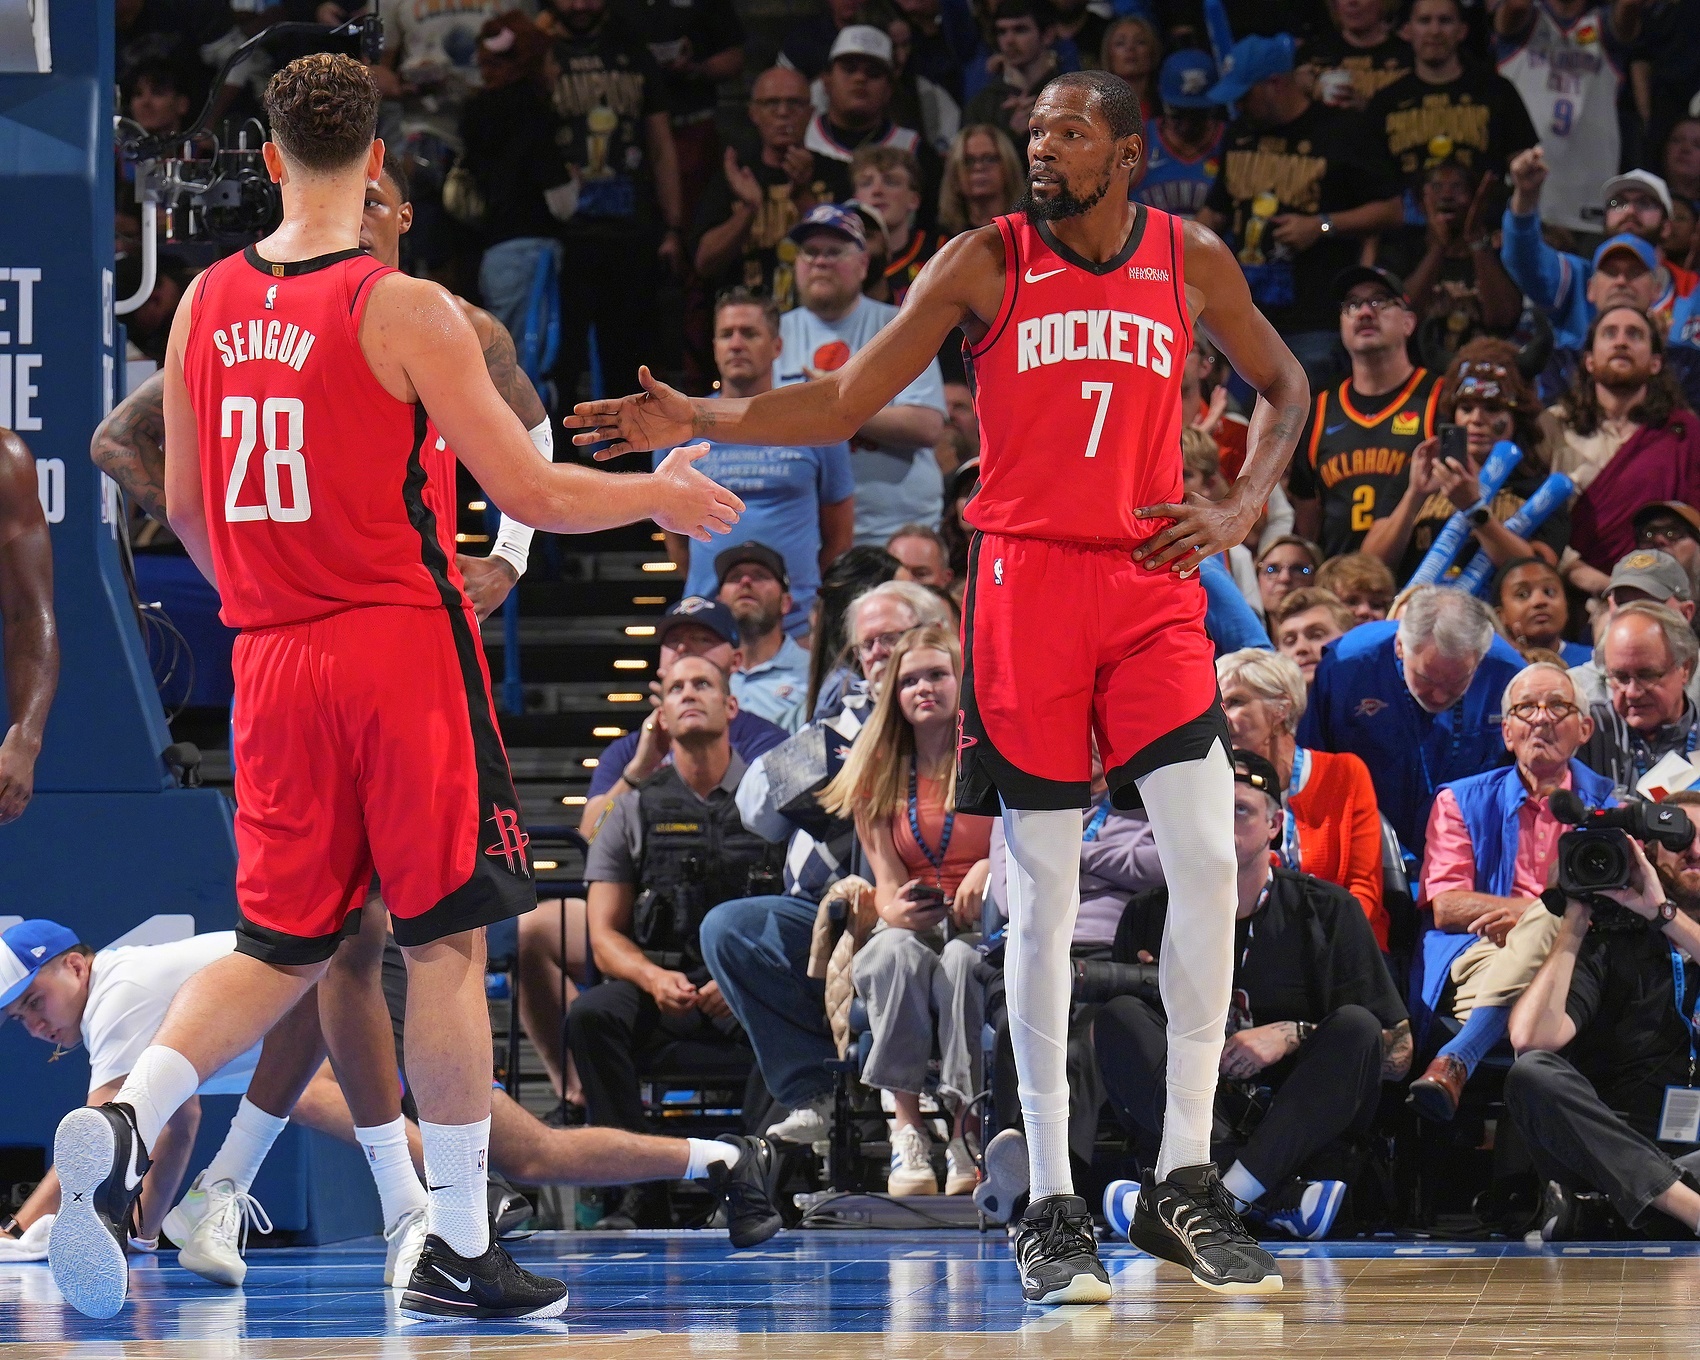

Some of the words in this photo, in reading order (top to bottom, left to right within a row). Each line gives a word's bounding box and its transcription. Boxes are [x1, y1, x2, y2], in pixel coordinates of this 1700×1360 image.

[1552, 99, 1573, 136] 9
[1129, 267, 1168, 276] MEMORIAL
[1129, 272, 1170, 282] HERMANN
[213, 319, 316, 372] SENGUN
[1017, 309, 1174, 379] ROCKETS
[1081, 381, 1114, 458] 7
[221, 396, 312, 522] 28
[1320, 447, 1408, 489] OKLAHOM
[1351, 484, 1376, 532] 2
